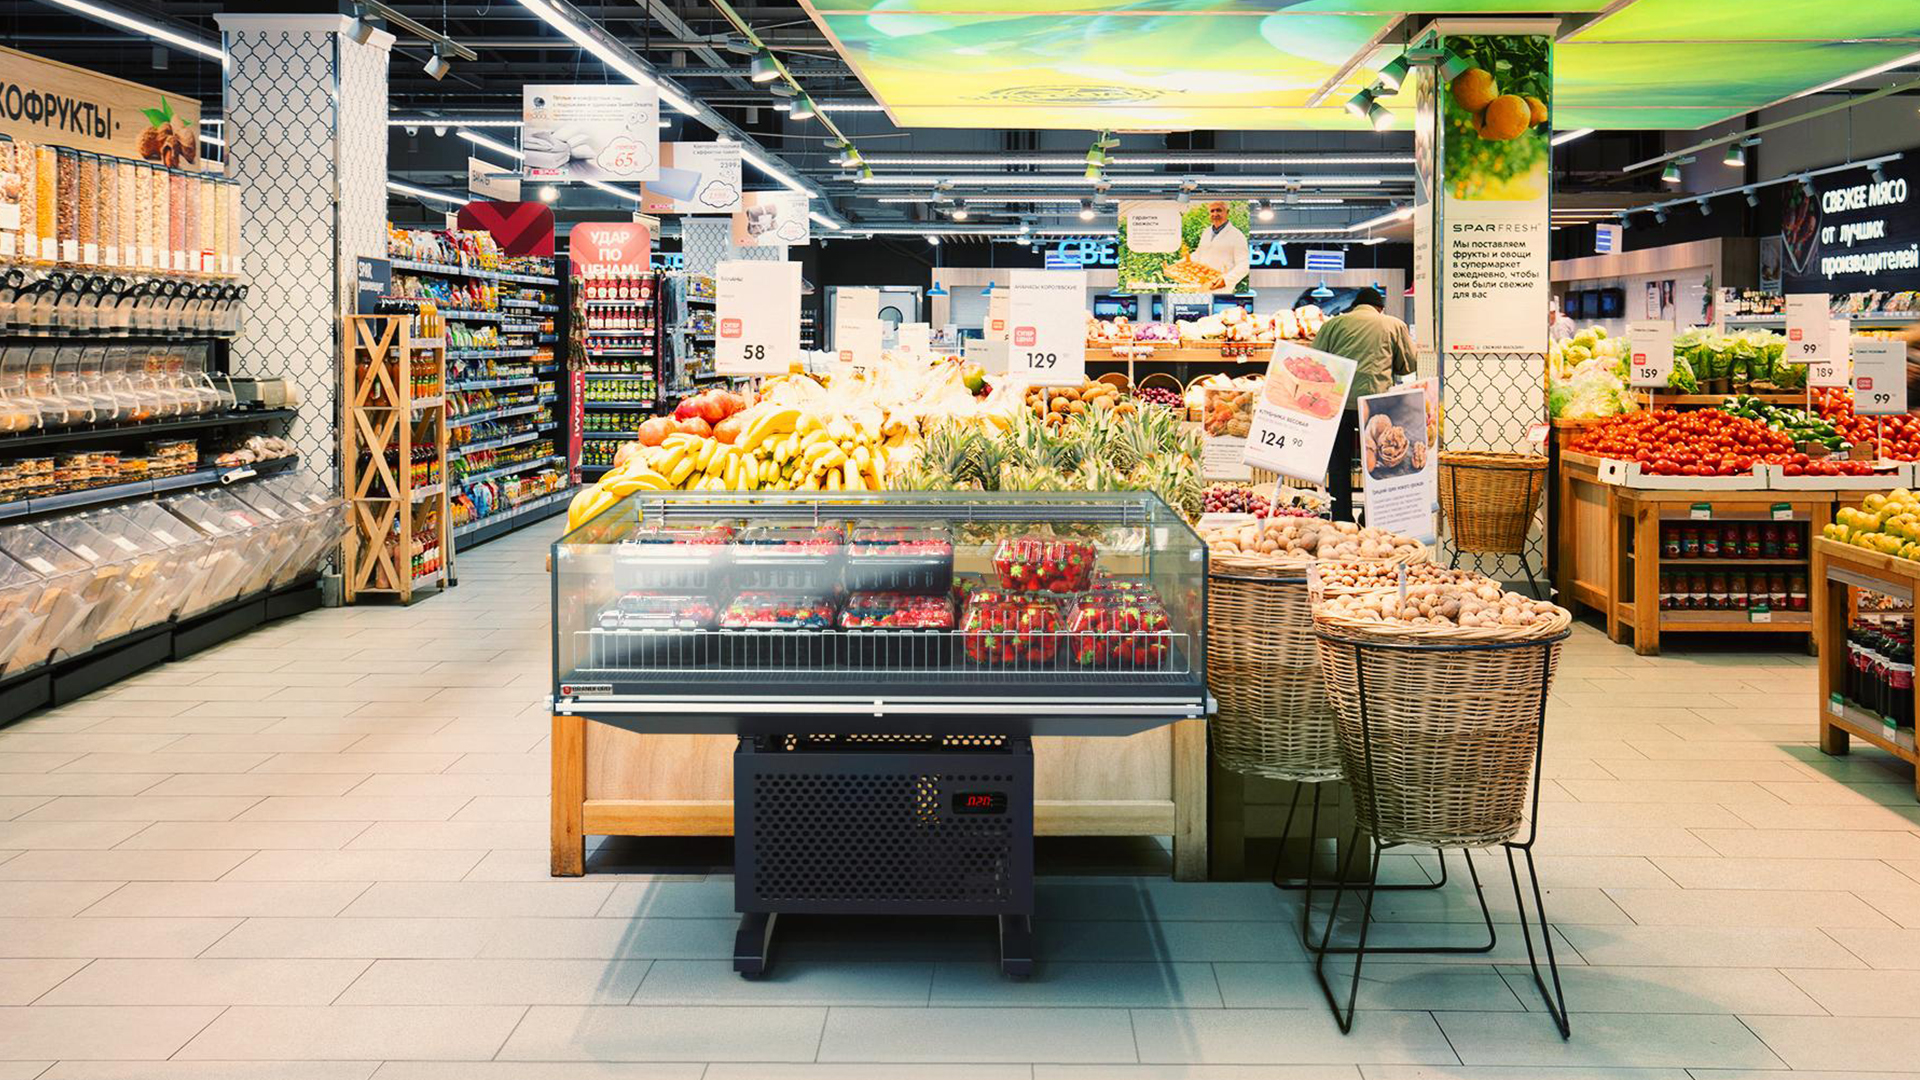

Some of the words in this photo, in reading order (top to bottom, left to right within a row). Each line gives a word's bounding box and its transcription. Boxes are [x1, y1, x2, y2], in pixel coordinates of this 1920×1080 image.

[1822, 185, 1867, 214] СВЕЖЕЕ
[1868, 178, 1907, 207] МЯСО
[1453, 224, 1496, 232] SPAR
[590, 231, 630, 246] УДАР
[1453, 240, 1469, 248] Мы
[598, 248, 622, 262] ПО
[1057, 237, 1118, 266] СВЕ
[1453, 250, 1490, 259] фрукты
[1500, 251, 1531, 259] овощи
[1461, 261, 1520, 270] супермаркет
[1821, 243, 1919, 280] производителей
[1453, 271, 1507, 279] ежедневно,
[1510, 271, 1539, 279] чтобы
[1472, 280, 1496, 288] были
[1499, 281, 1534, 289] свежие
[1453, 291, 1469, 299] для
[743, 344, 765, 360] 58
[1803, 344, 1817, 354] 99
[1026, 353, 1057, 369] 129
[1640, 369, 1658, 379] 159
[1816, 367, 1833, 377] 189
[1874, 393, 1890, 404] 99
[1261, 430, 1286, 449] 124
[1292, 438, 1303, 448] 90
